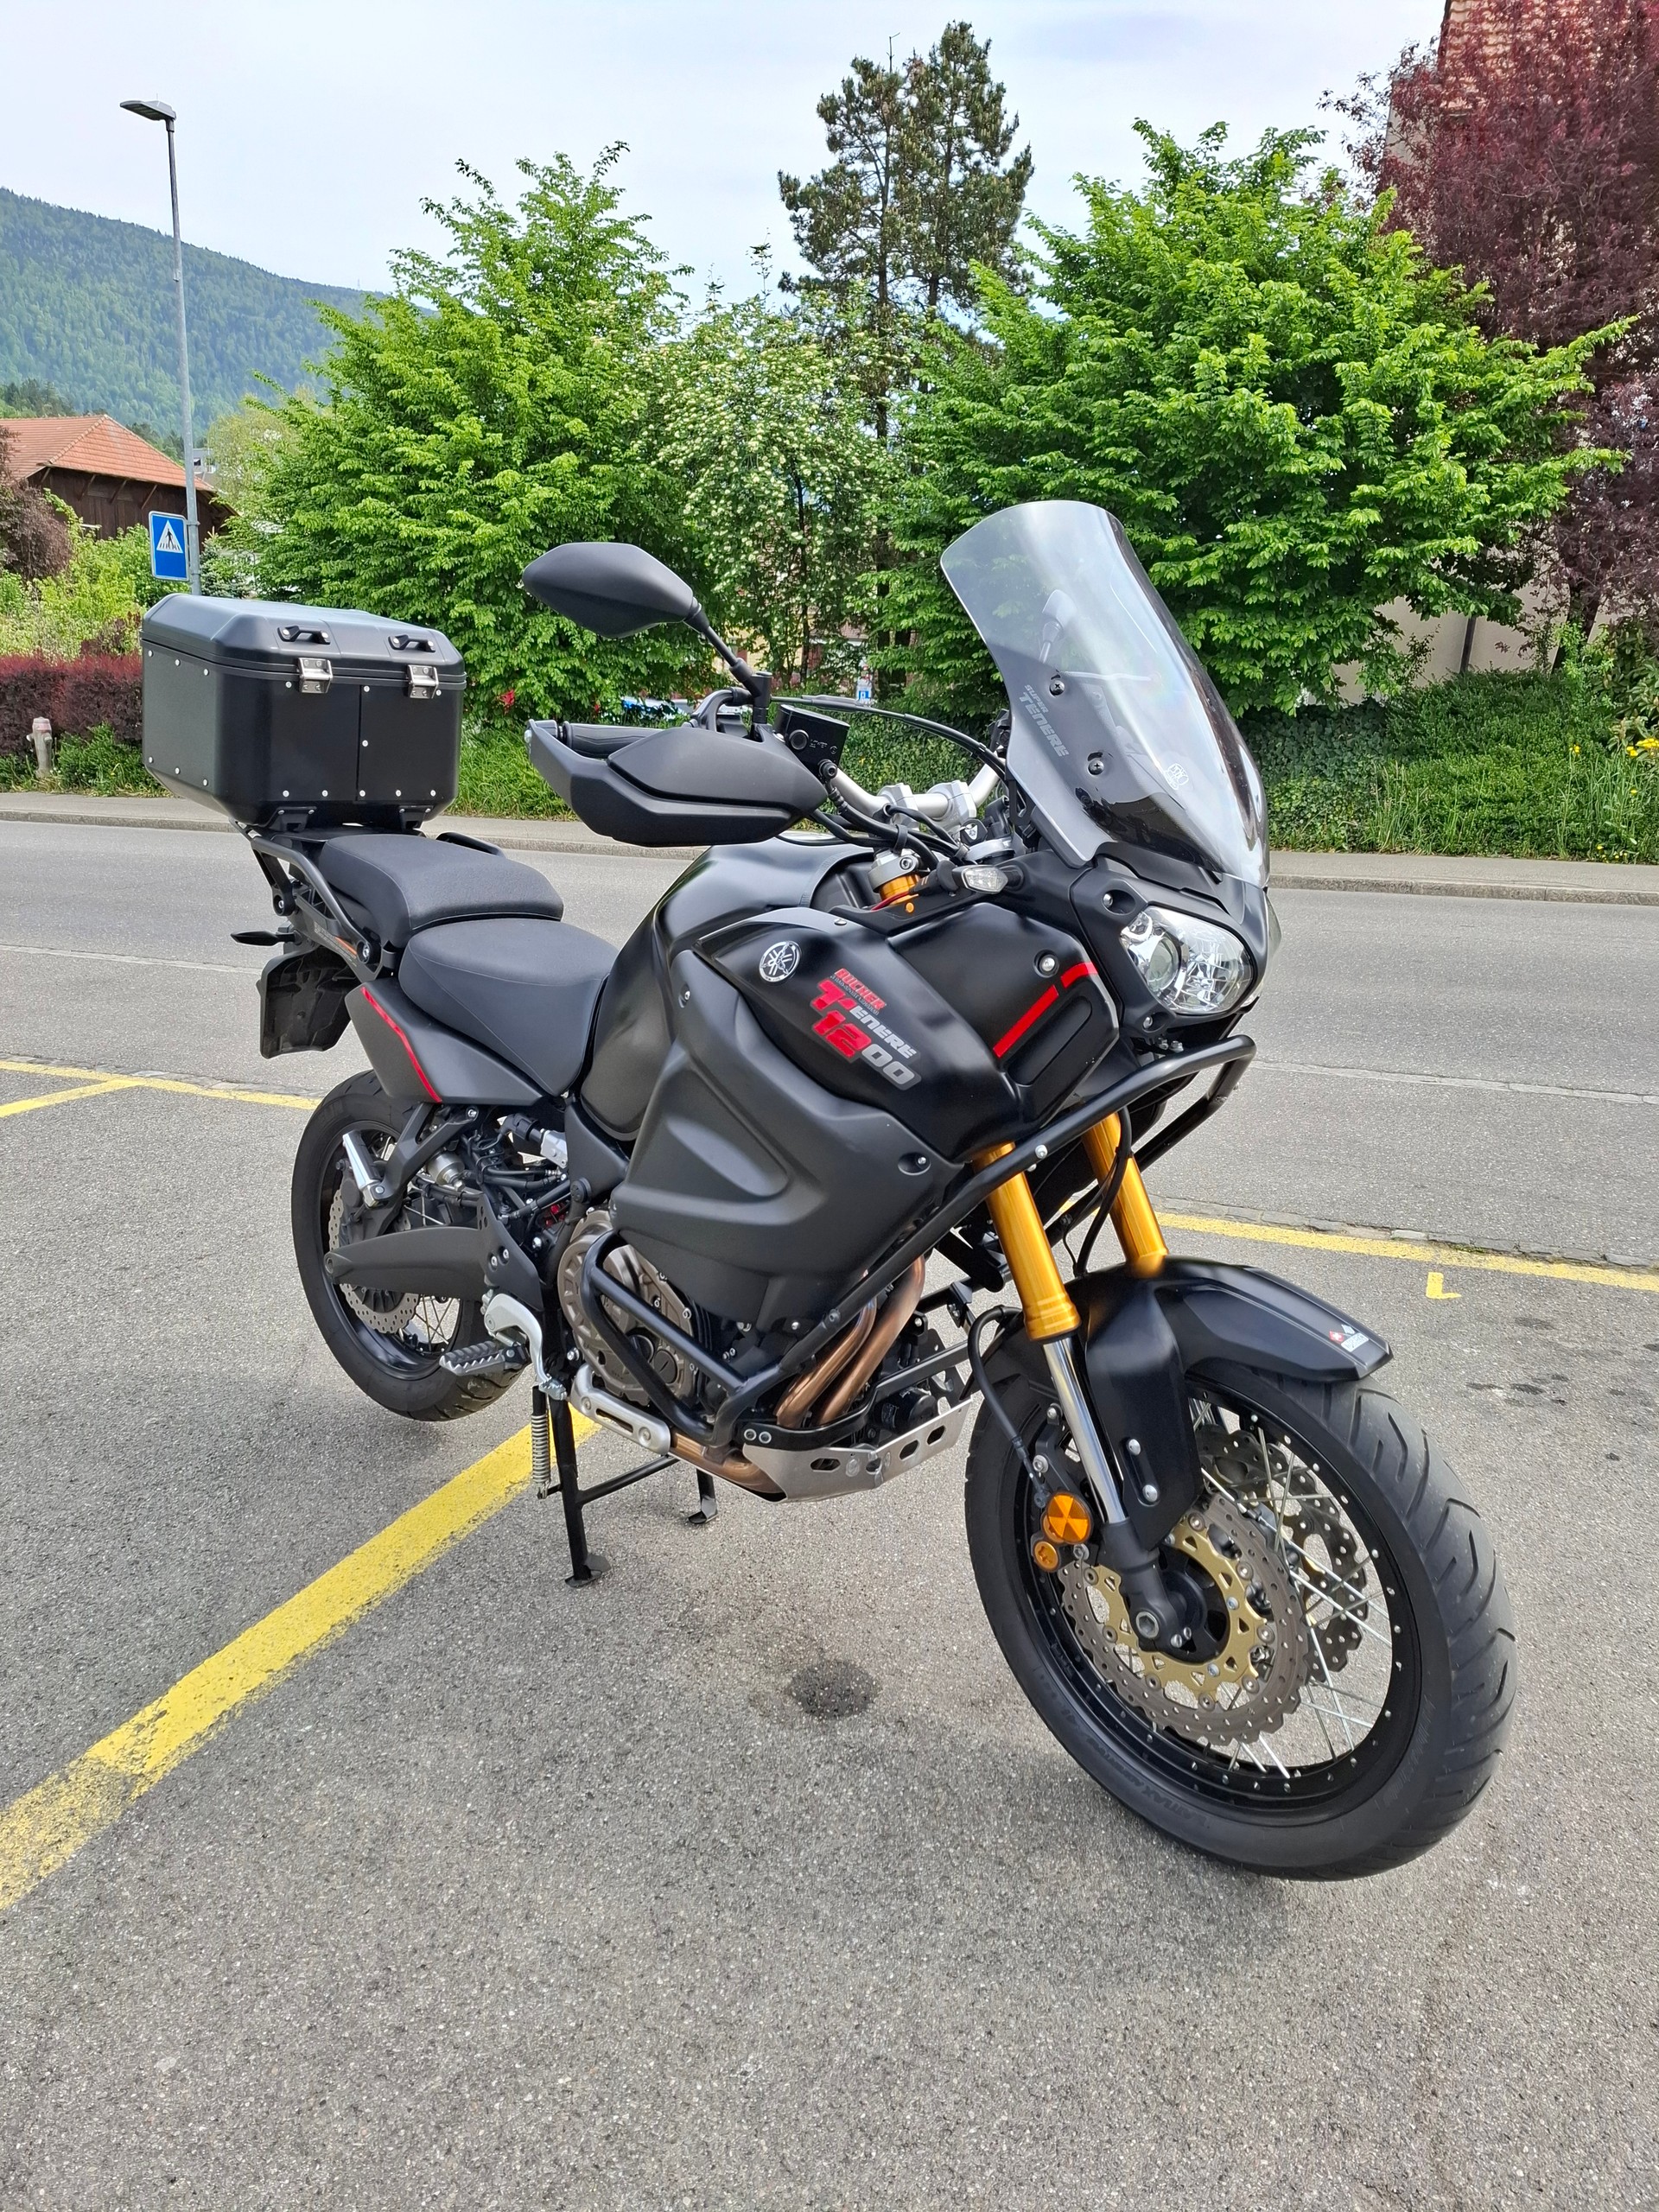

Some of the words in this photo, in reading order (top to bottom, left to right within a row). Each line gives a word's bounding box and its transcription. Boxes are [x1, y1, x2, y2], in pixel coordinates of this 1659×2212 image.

[1019, 691, 1070, 757] TENERE
[1024, 684, 1049, 714] SUPER
[812, 1010, 915, 1084] 1200
